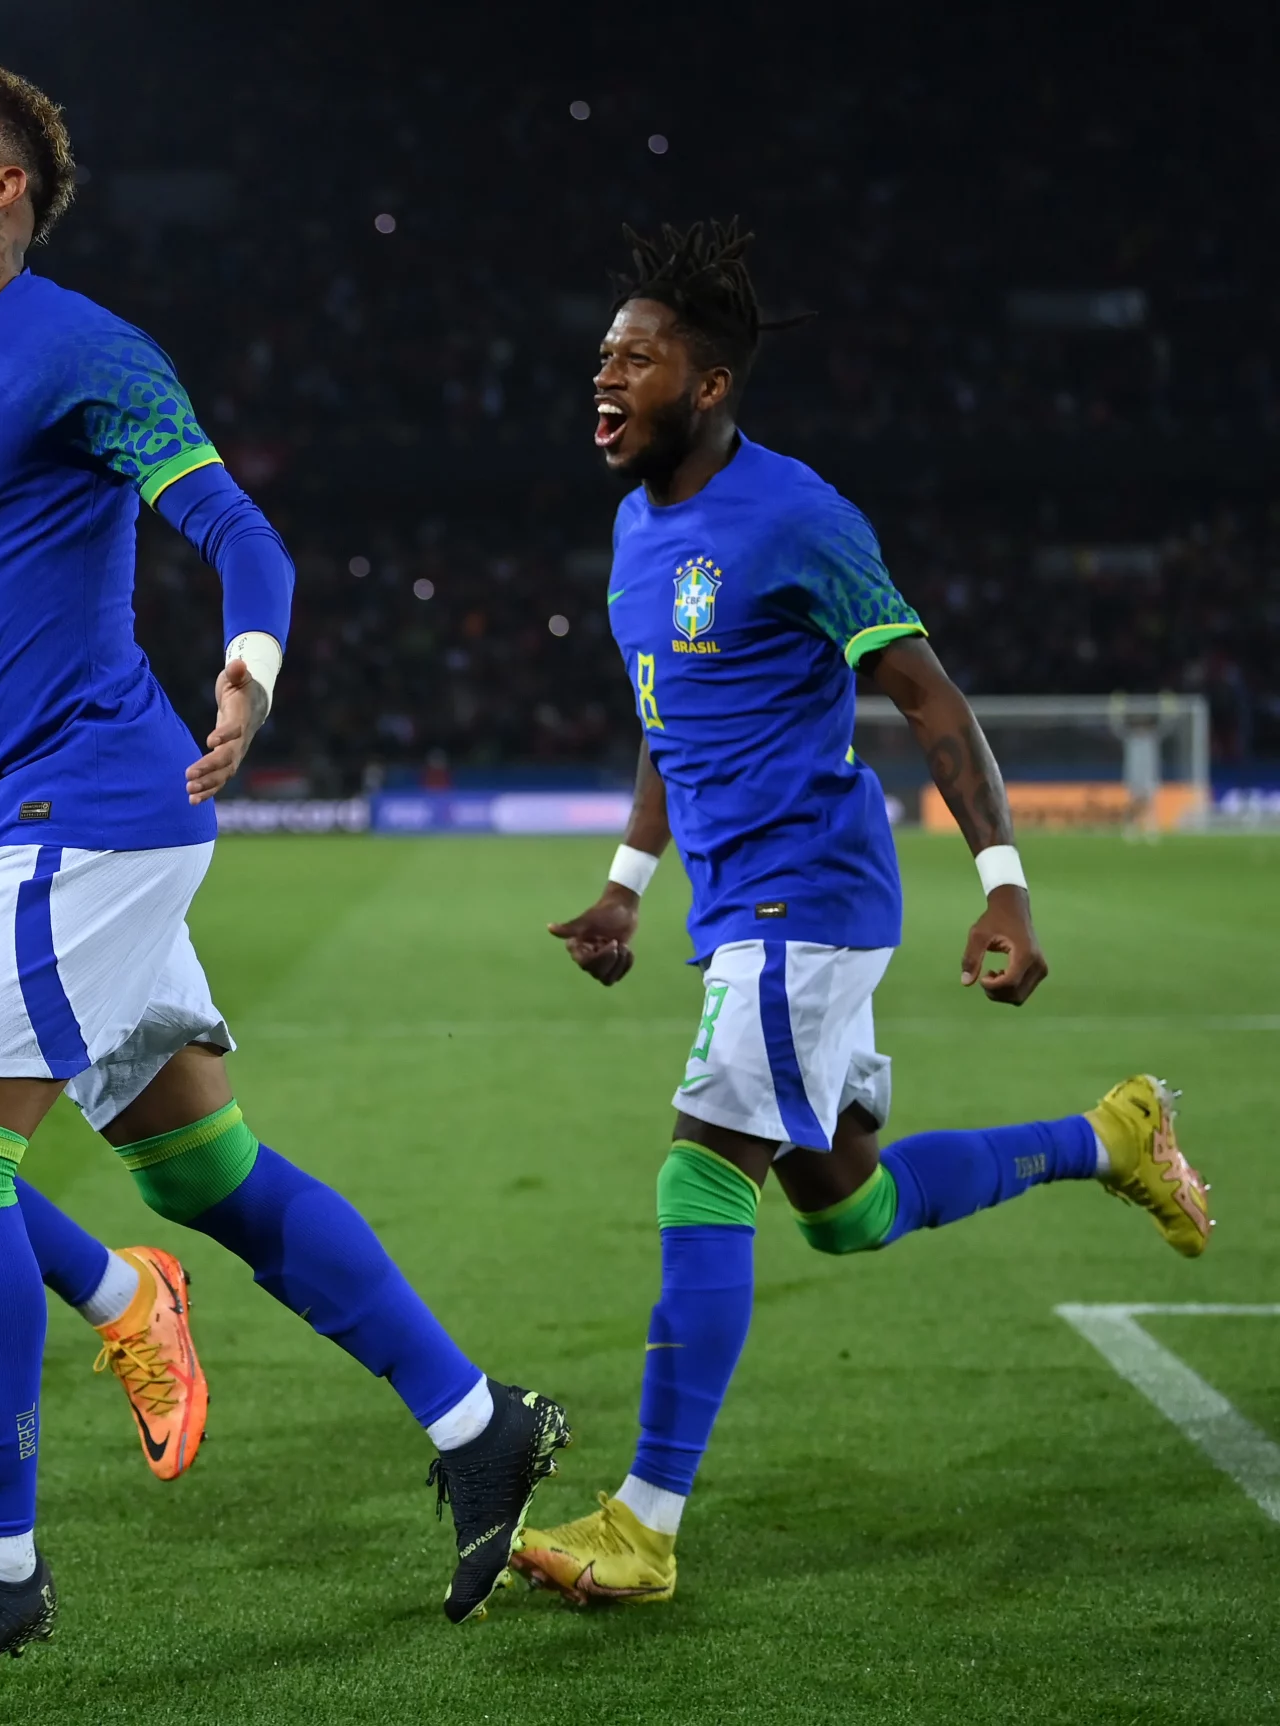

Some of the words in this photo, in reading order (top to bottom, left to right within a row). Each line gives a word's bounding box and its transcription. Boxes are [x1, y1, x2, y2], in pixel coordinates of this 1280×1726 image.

[685, 596, 701, 605] CBF
[672, 639, 721, 654] BRASIL
[637, 651, 665, 731] 8
[691, 985, 729, 1062] 8
[16, 1402, 36, 1460] BRASIL
[459, 1543, 477, 1559] TUDO
